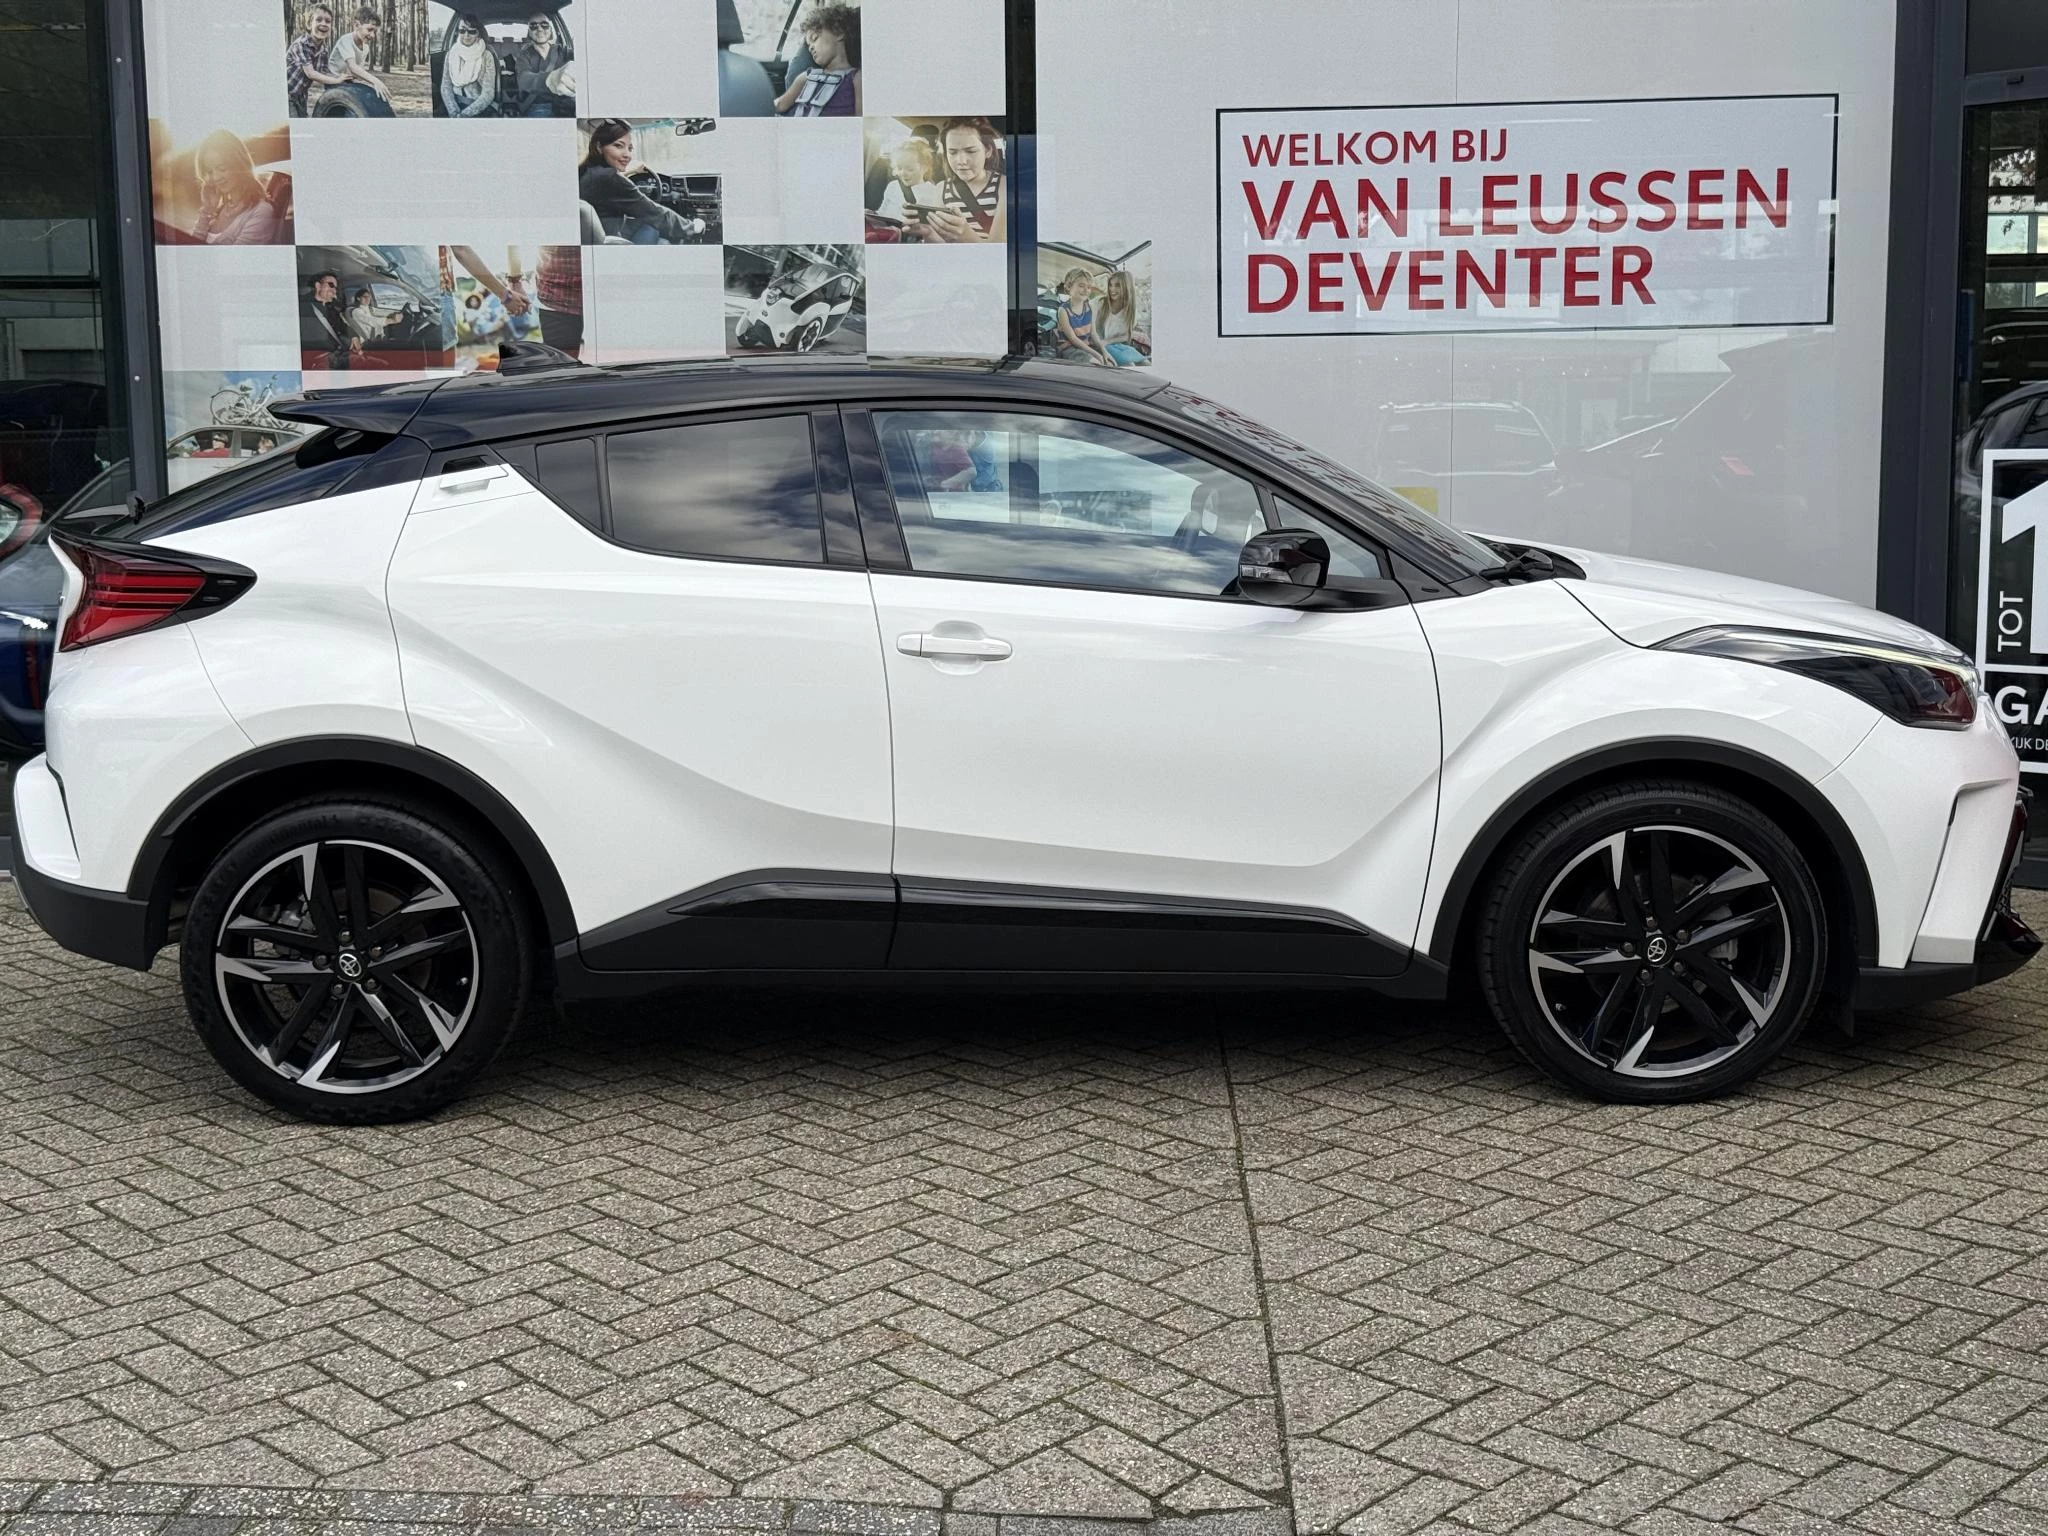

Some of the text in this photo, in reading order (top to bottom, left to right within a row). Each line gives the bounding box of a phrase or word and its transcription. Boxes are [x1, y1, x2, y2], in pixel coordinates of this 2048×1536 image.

[1242, 128, 1508, 167] WELKOM BIJ
[1241, 168, 1789, 240] VAN LEUSSEN
[1247, 246, 1656, 313] DEVENTER
[1997, 591, 2024, 653] TOT
[2010, 736, 2032, 749] IJK
